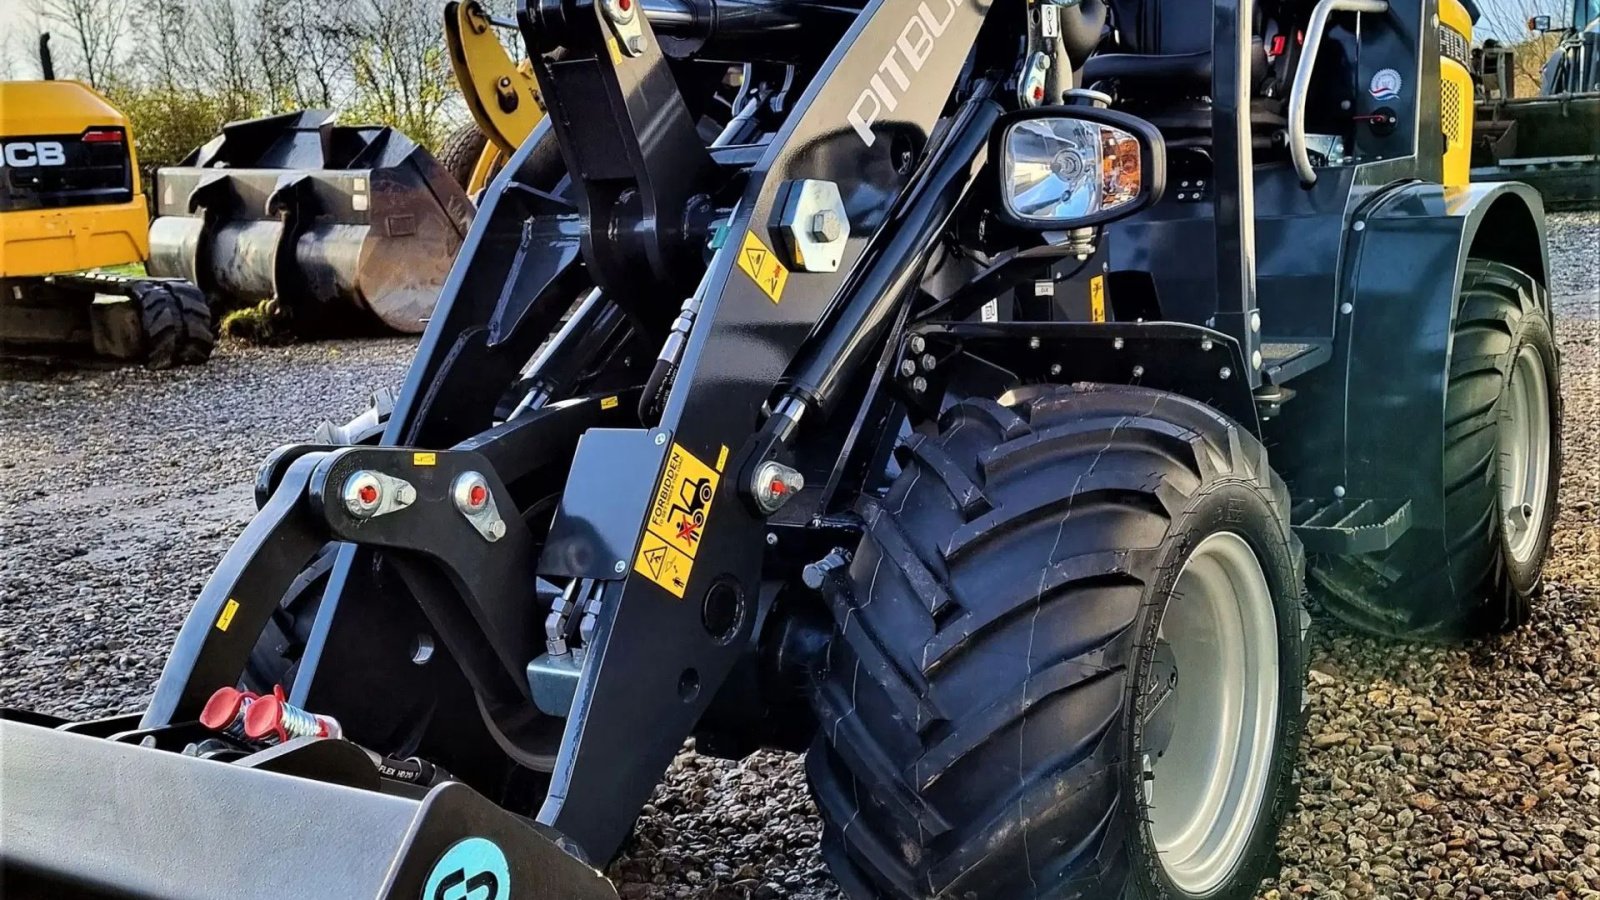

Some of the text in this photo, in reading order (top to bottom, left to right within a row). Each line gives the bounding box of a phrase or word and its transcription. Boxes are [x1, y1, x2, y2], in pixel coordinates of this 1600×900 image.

[847, 0, 964, 147] PITBU
[0, 141, 66, 168] CB
[652, 452, 681, 526] FORBIDDEN
